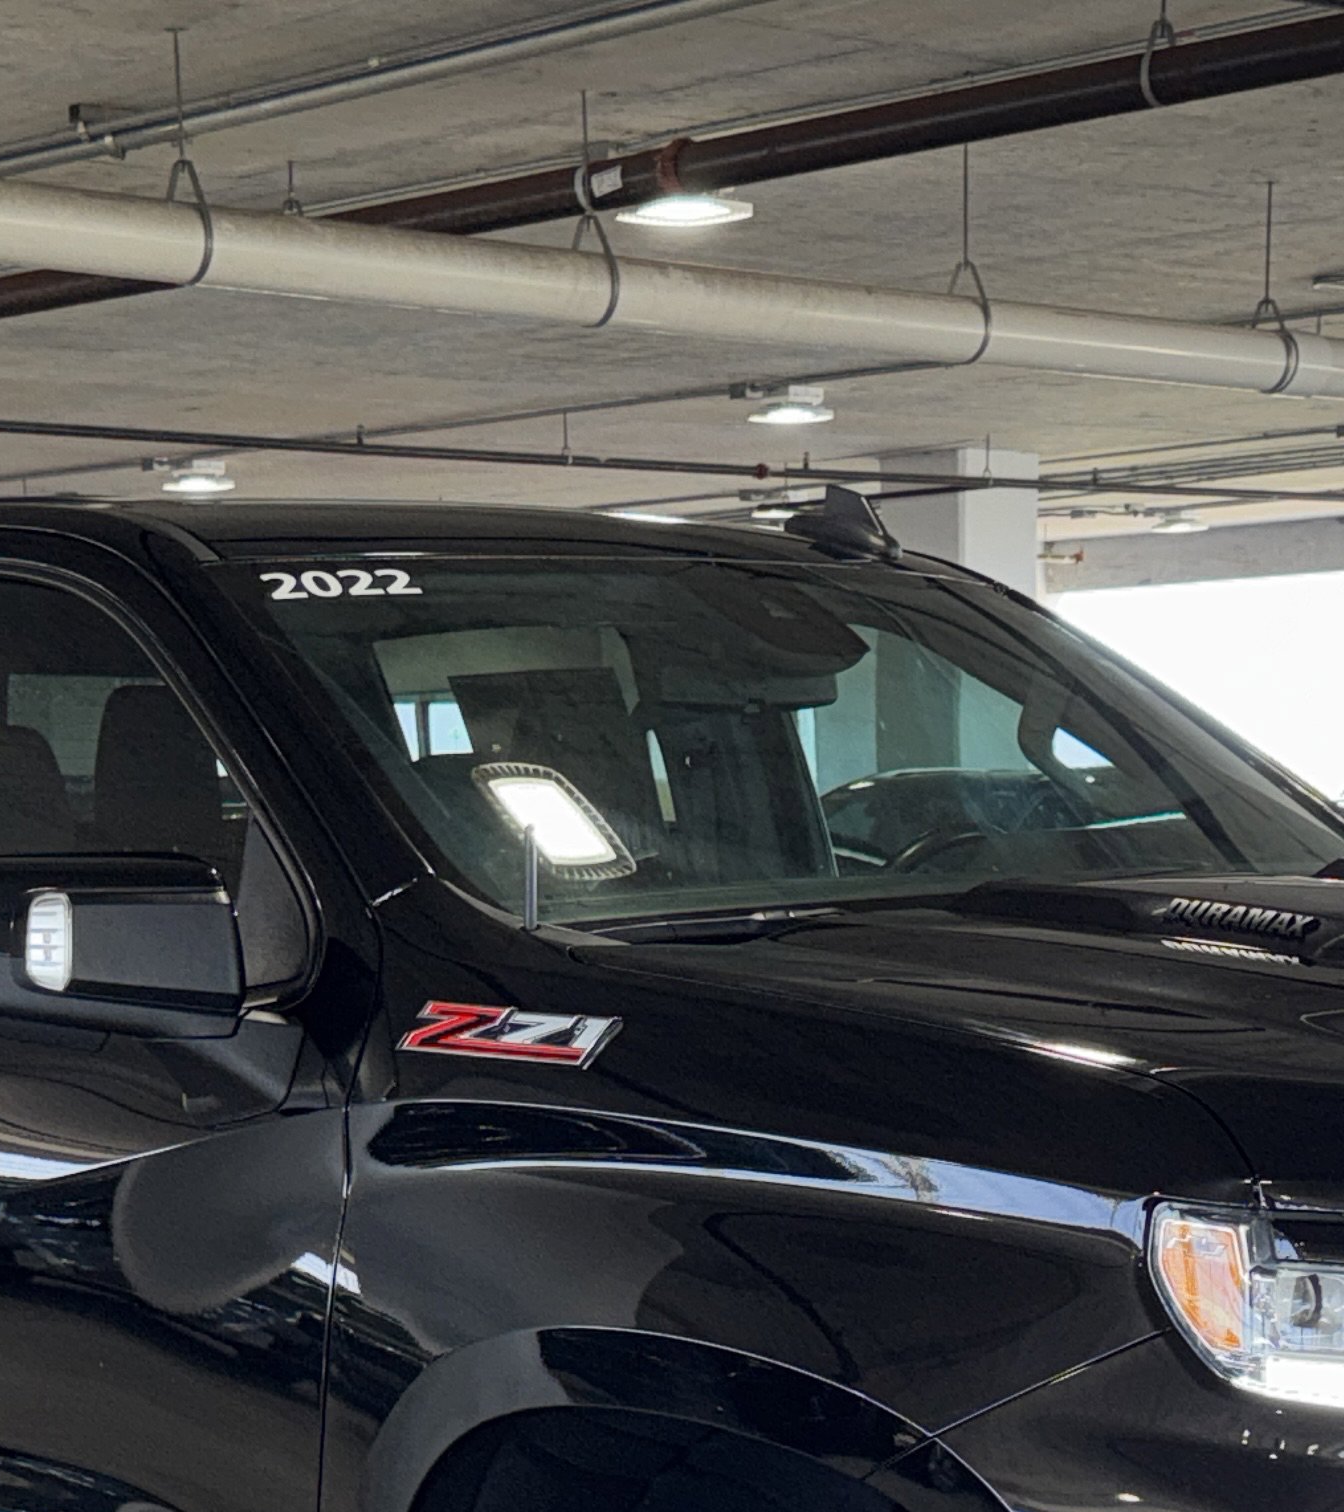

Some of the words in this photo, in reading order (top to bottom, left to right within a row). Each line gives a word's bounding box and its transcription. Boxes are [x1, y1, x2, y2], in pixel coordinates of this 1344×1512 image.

[259, 568, 424, 601] 2022
[1164, 897, 1316, 937] DURAMAX
[394, 999, 624, 1071] Z71
